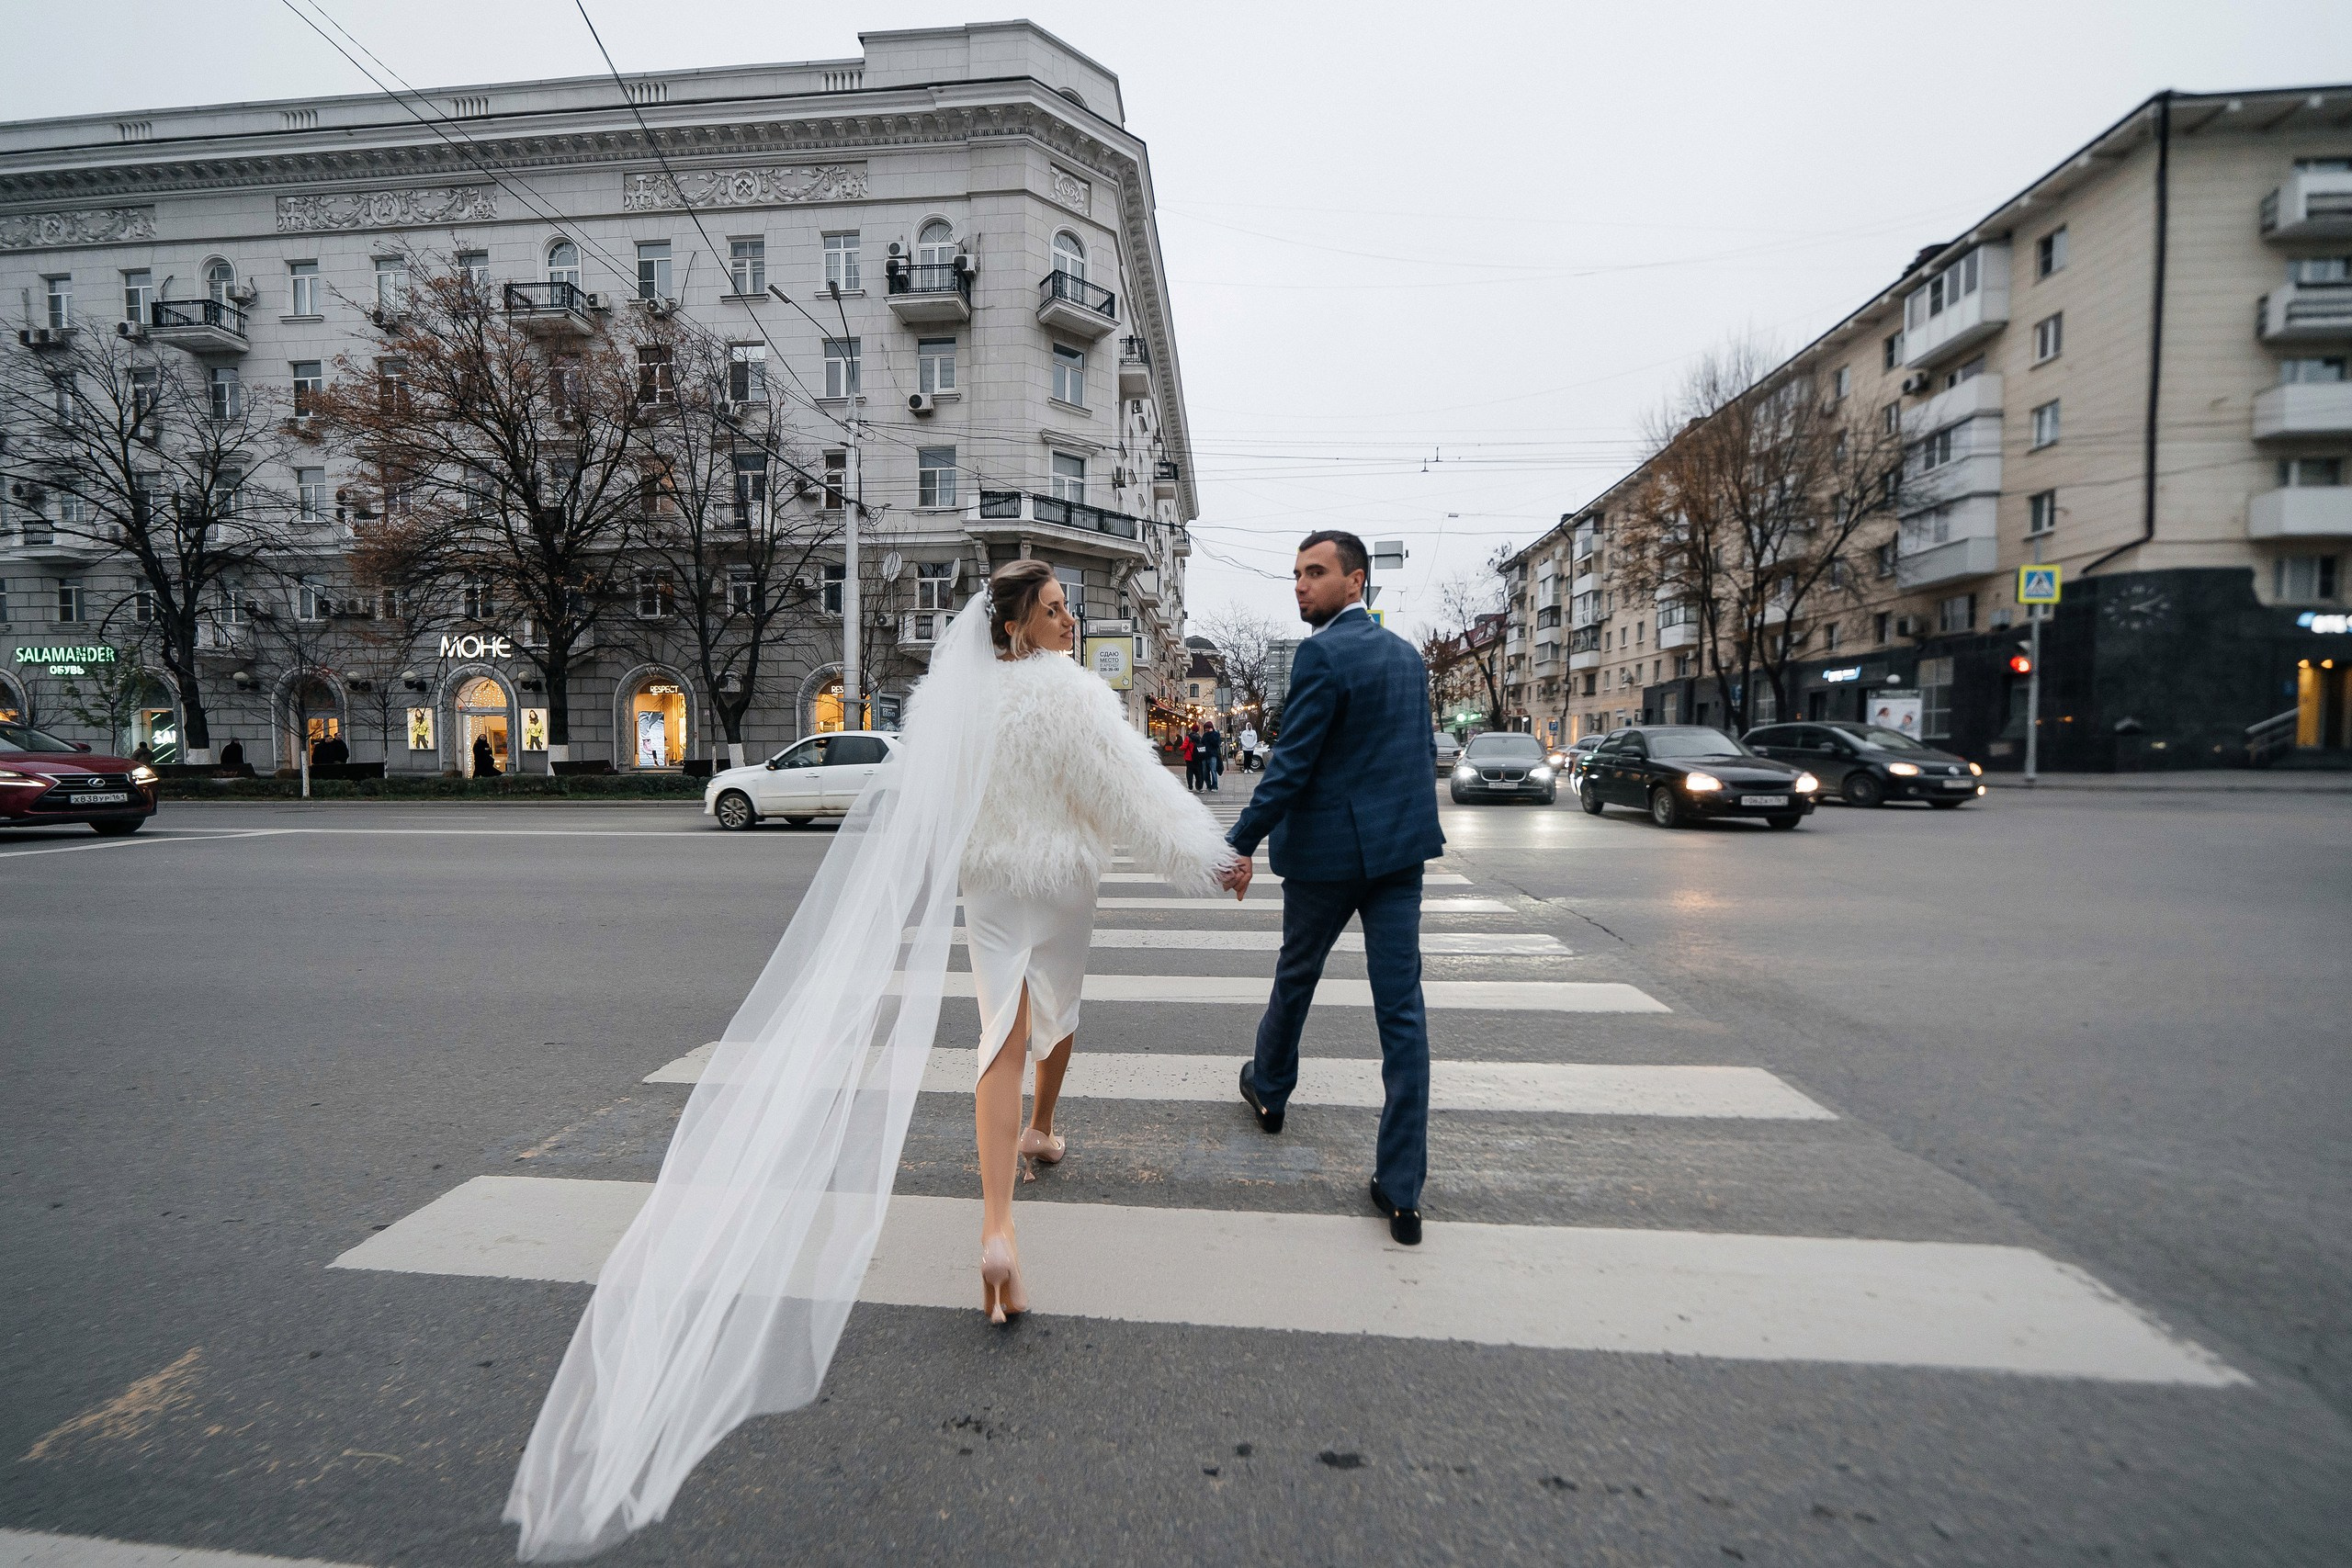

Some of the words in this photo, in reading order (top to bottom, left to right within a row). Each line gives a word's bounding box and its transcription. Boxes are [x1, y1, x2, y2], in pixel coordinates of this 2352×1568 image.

[1059, 183, 1081, 202] 1954
[16, 647, 115, 662] SALAMANDER
[50, 665, 85, 674] ОБУВЬ
